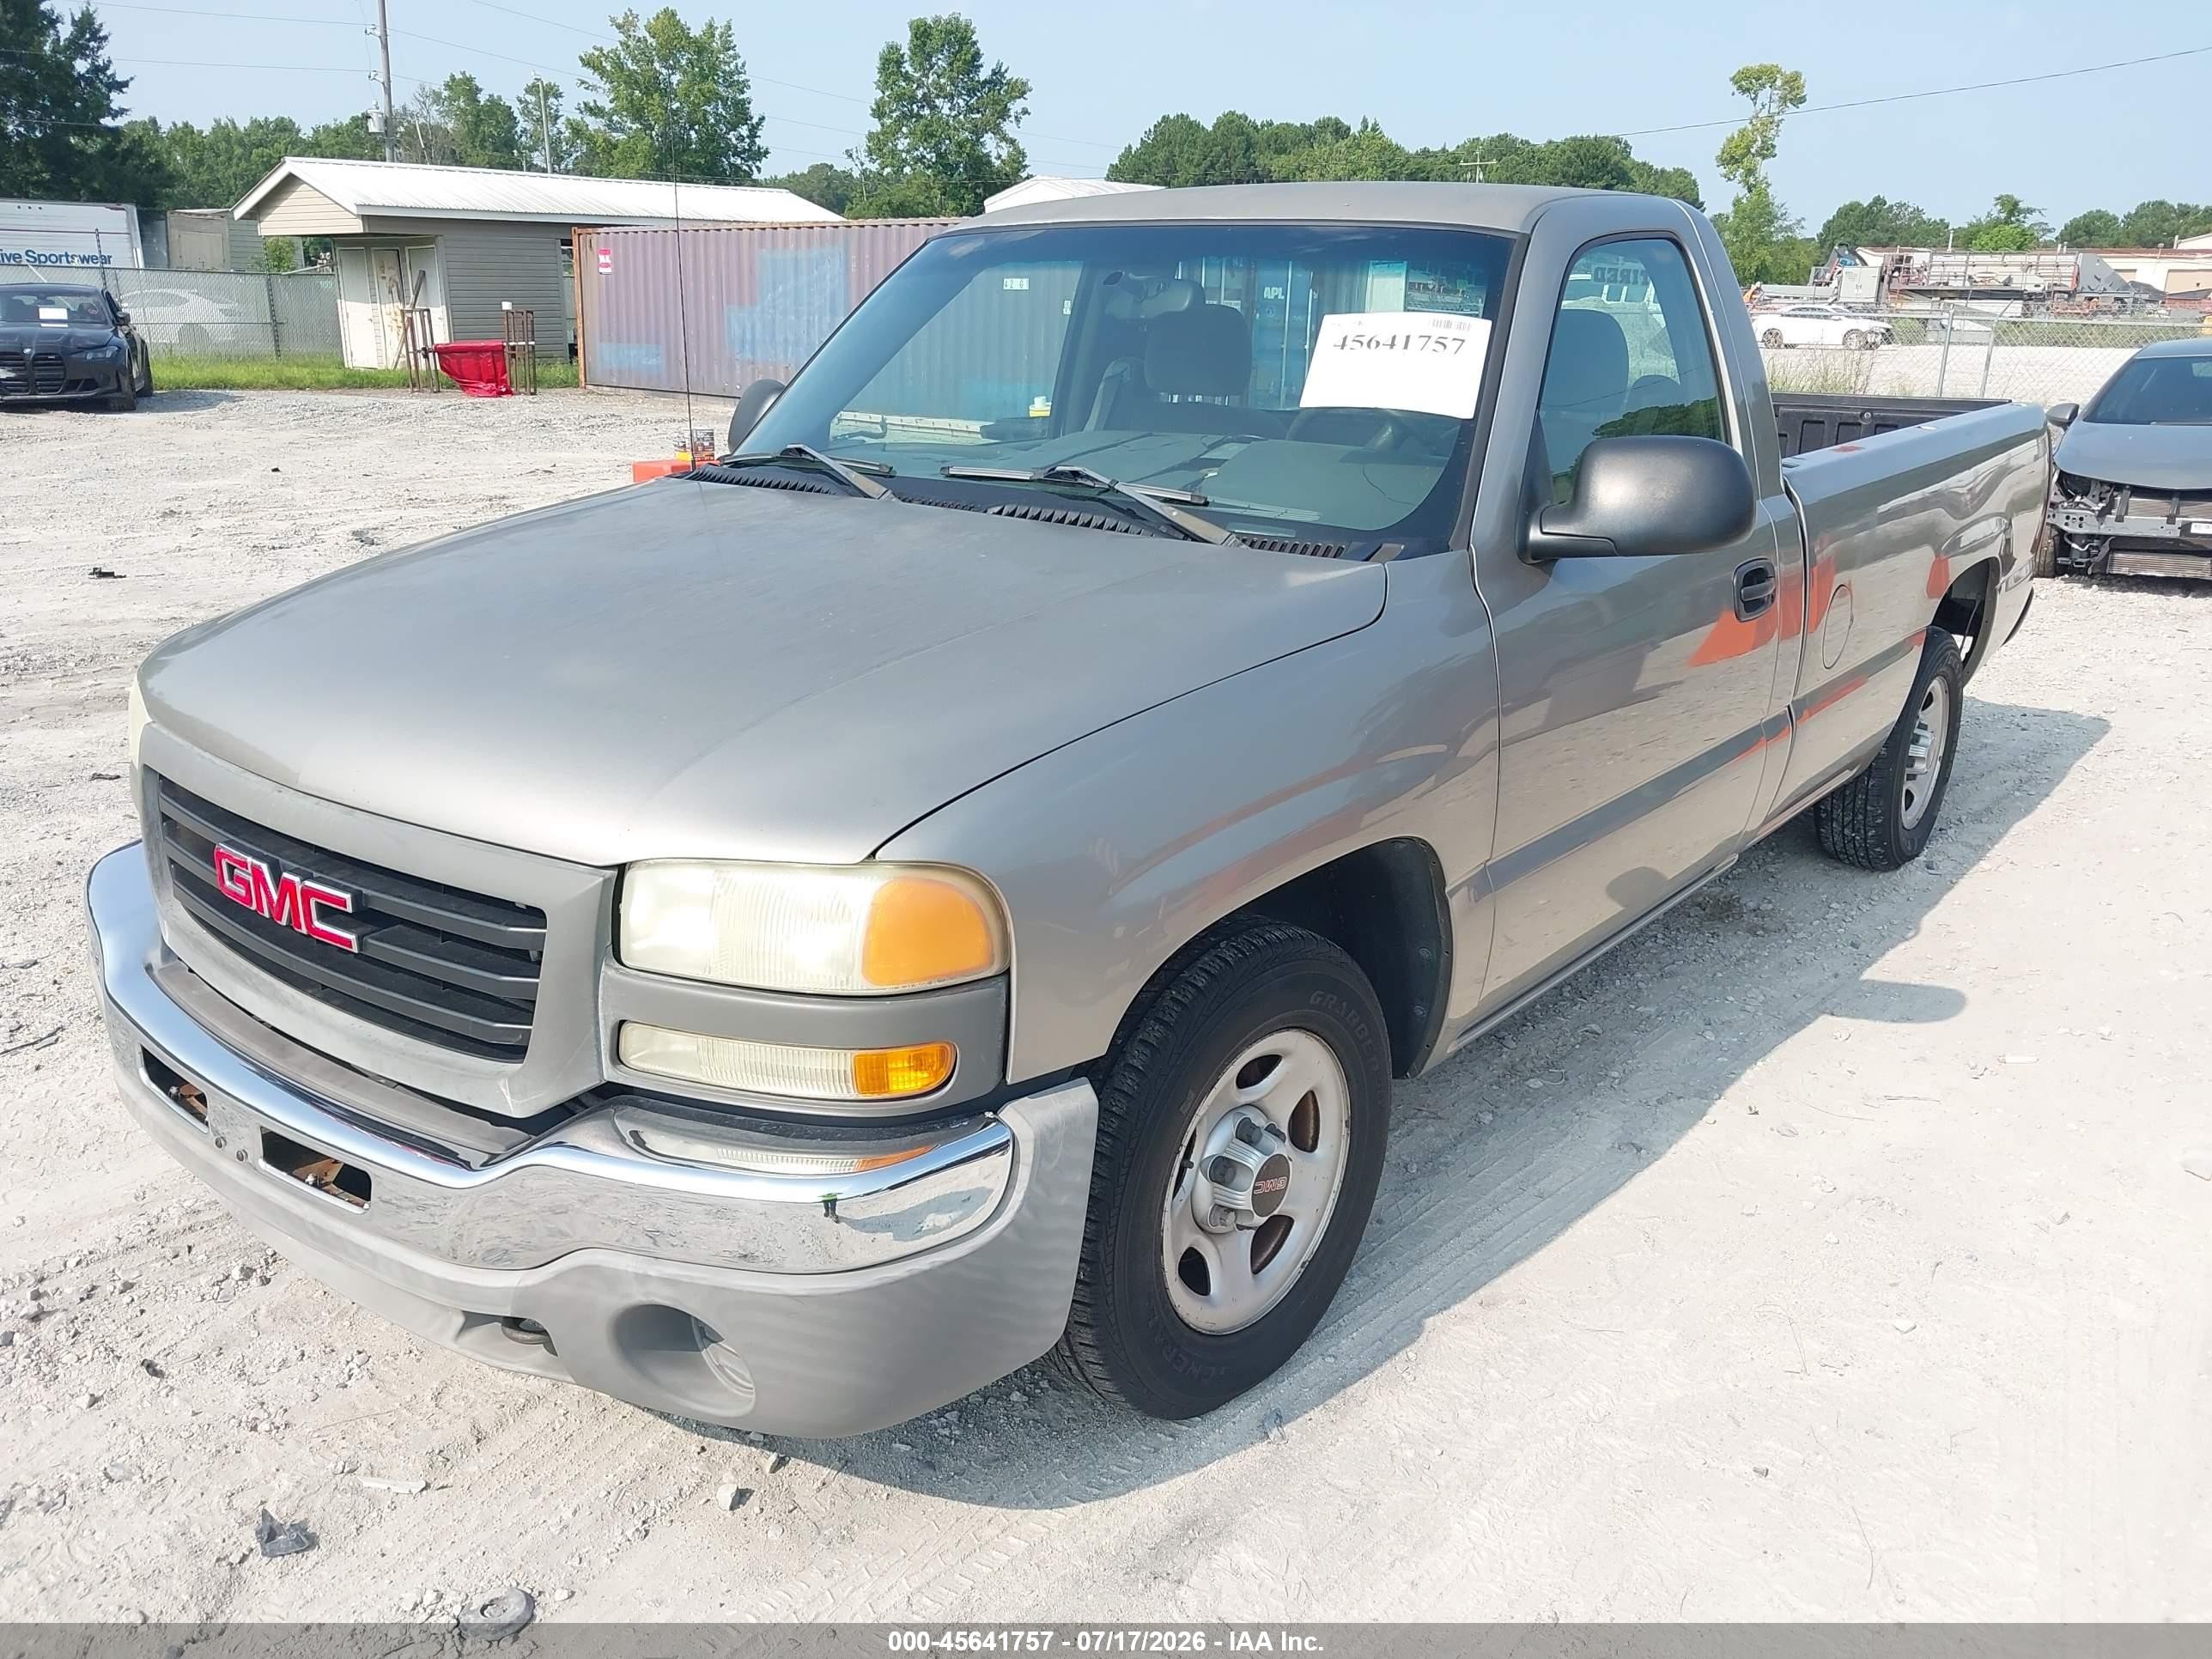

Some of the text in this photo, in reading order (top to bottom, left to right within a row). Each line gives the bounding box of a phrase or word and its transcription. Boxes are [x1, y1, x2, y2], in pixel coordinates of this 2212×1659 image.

[25, 249, 112, 264] Sportswear
[1263, 287, 1285, 300] APL
[1334, 333, 1466, 355] 45641757
[214, 842, 358, 953] GMC
[1254, 1176, 1287, 1194] GMC
